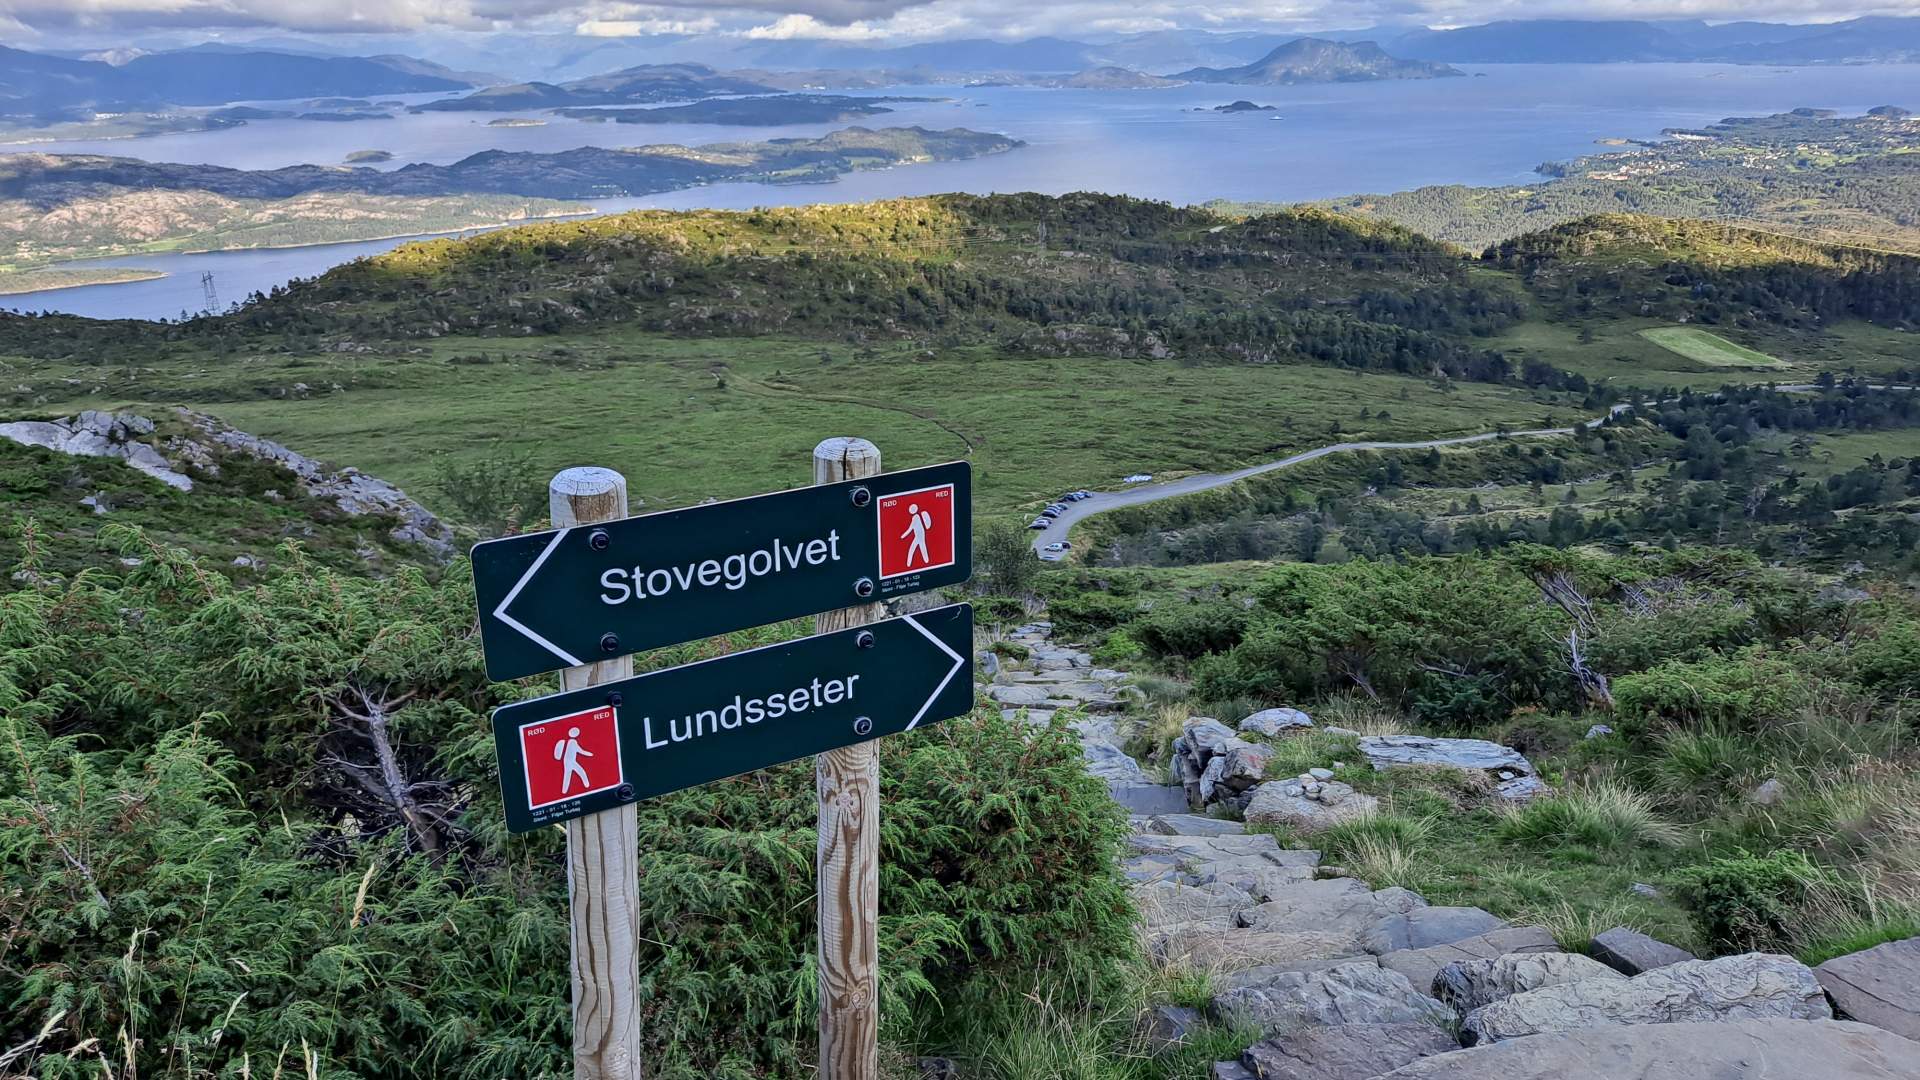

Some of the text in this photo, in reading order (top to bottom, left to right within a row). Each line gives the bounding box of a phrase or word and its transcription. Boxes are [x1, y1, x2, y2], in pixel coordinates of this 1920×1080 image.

[600, 529, 841, 605] Stovegolvet
[527, 727, 546, 737] RØD
[593, 711, 610, 721] RED
[643, 675, 860, 750] Lundsseter
